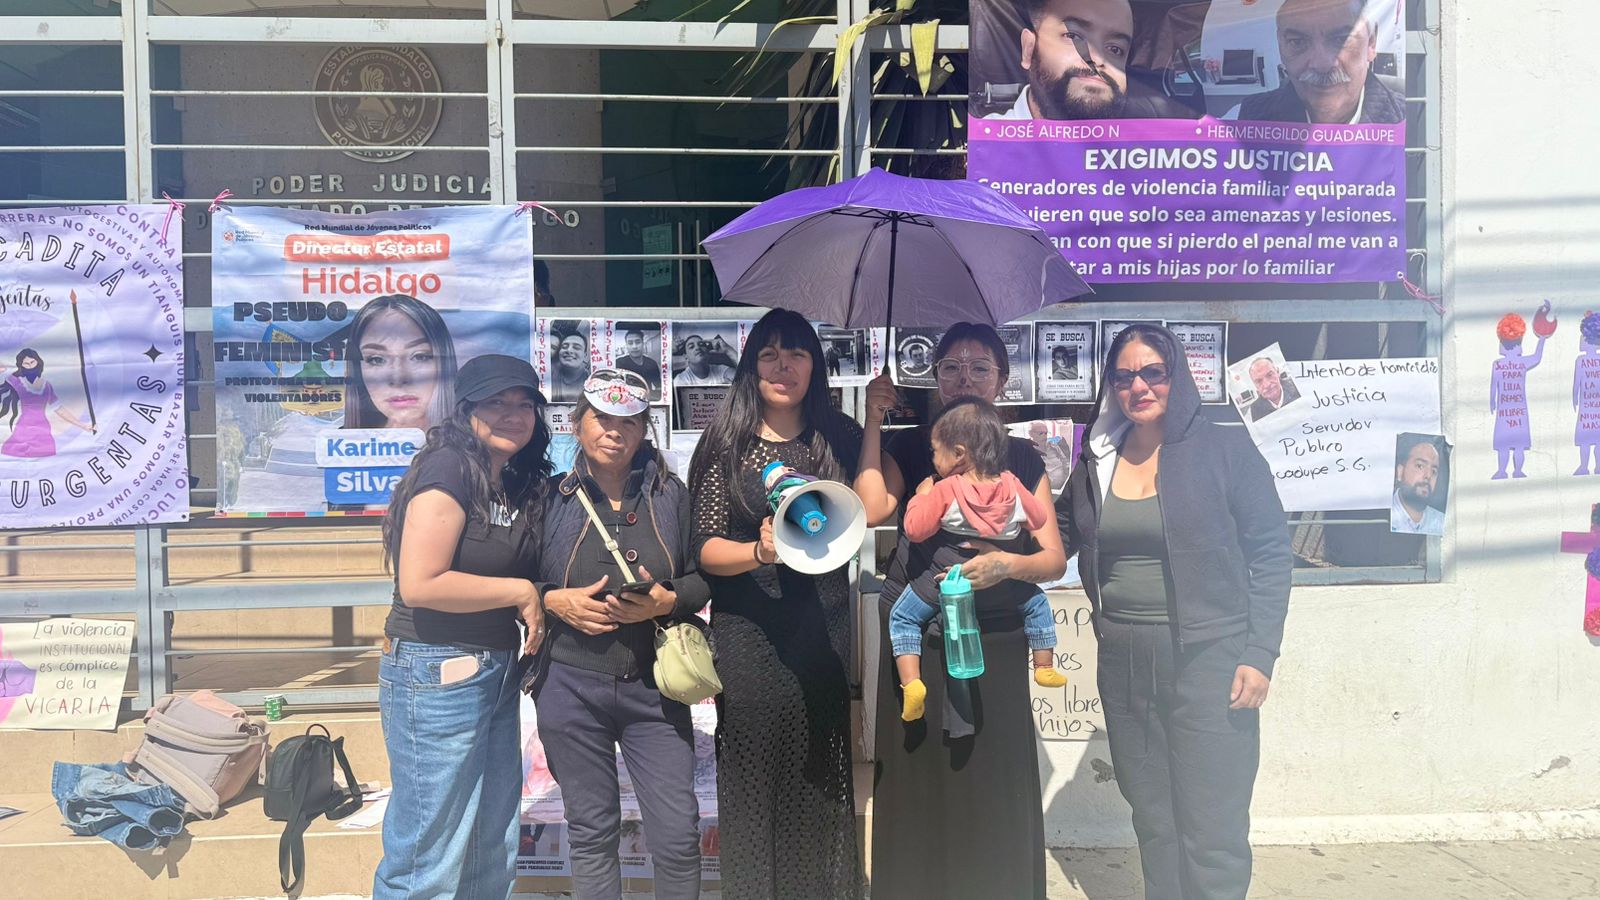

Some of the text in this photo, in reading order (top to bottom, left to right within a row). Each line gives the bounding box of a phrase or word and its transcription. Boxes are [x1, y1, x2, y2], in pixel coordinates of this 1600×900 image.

[997, 122, 1120, 139] JOSÉ ALFREDO N
[1207, 125, 1395, 143] HERMENEGILDO GUADALUPE
[1085, 148, 1334, 172] EXIGIMOS JUSTICIA
[252, 173, 492, 195] PODER JUDICIA
[1102, 180, 1126, 196] de
[1131, 179, 1217, 195] violencia
[1223, 179, 1289, 197] familiar
[1295, 181, 1396, 200] equiparada
[63, 218, 84, 232] NO
[1024, 206, 1397, 227] uieren que solo sea amenazas y lesiones.
[116, 205, 176, 259] CONTRA
[87, 228, 132, 261] SOMOS
[293, 240, 443, 257] Director Estatal
[1050, 233, 1398, 253] an con que si pierdo el penal me van a
[64, 206, 139, 244] UTOGESTIVAS
[146, 252, 182, 304] AUTONOM
[131, 260, 150, 279] UN
[1101, 263, 1112, 275] a
[1118, 259, 1151, 275] mis
[1157, 259, 1201, 279] hijas
[1206, 262, 1238, 279] por
[1243, 259, 1259, 275] lo
[1264, 259, 1336, 275] familiar
[302, 267, 442, 297] Hidalgo
[148, 280, 183, 347] TIANGUIS
[234, 301, 348, 322] PSEUDO
[1045, 333, 1086, 341] SE BUSCA
[1190, 333, 1216, 342] BUSCA
[1295, 360, 1439, 379] Intento de homicidio
[244, 393, 342, 403] VIOLENTADORES
[1312, 386, 1387, 409] Justicia
[163, 392, 182, 439] BAZAR
[552, 414, 563, 423] SE
[1302, 418, 1372, 435] Servidor
[327, 438, 416, 456] Karime
[1278, 438, 1343, 456] Publico
[133, 443, 165, 487] SOMOS
[107, 488, 132, 510] UNA
[33, 622, 127, 640] La violencia
[40, 643, 129, 657] INSTITUCIONAL
[40, 660, 119, 673] es cómplice
[56, 676, 97, 690] de la
[25, 696, 112, 715] VICARIA
[1038, 713, 1098, 737] hijos
